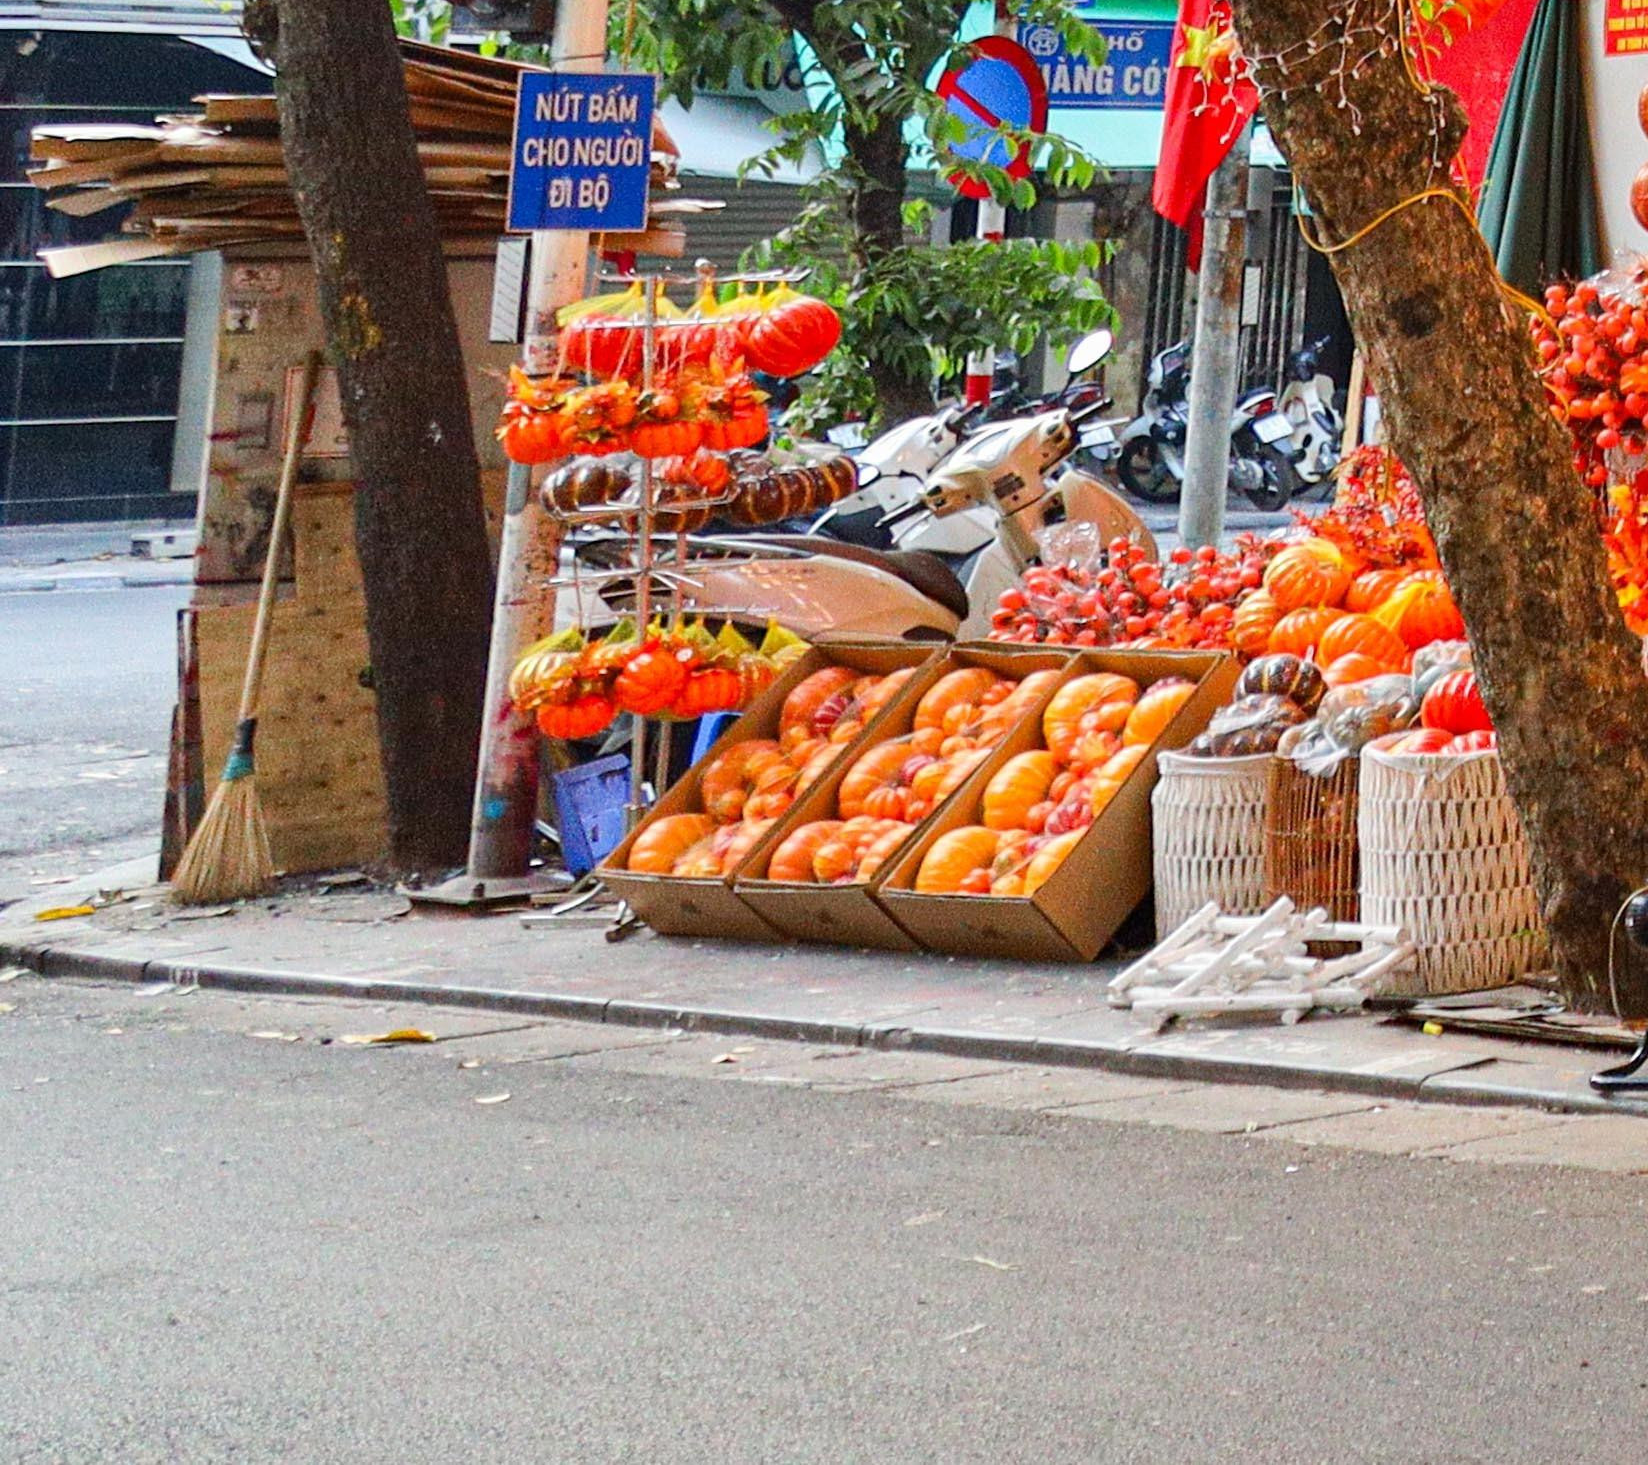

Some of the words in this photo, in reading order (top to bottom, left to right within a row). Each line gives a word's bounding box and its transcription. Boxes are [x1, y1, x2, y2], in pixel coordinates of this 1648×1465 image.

[1106, 29, 1146, 52] HỐ
[1123, 58, 1169, 95] CÓ
[535, 86, 584, 123] NÚT
[588, 84, 639, 123] BẤM
[523, 137, 570, 167] CHO
[573, 129, 644, 167] NGƯỜI
[549, 177, 573, 208] ĐI
[578, 173, 610, 213] BỘ
